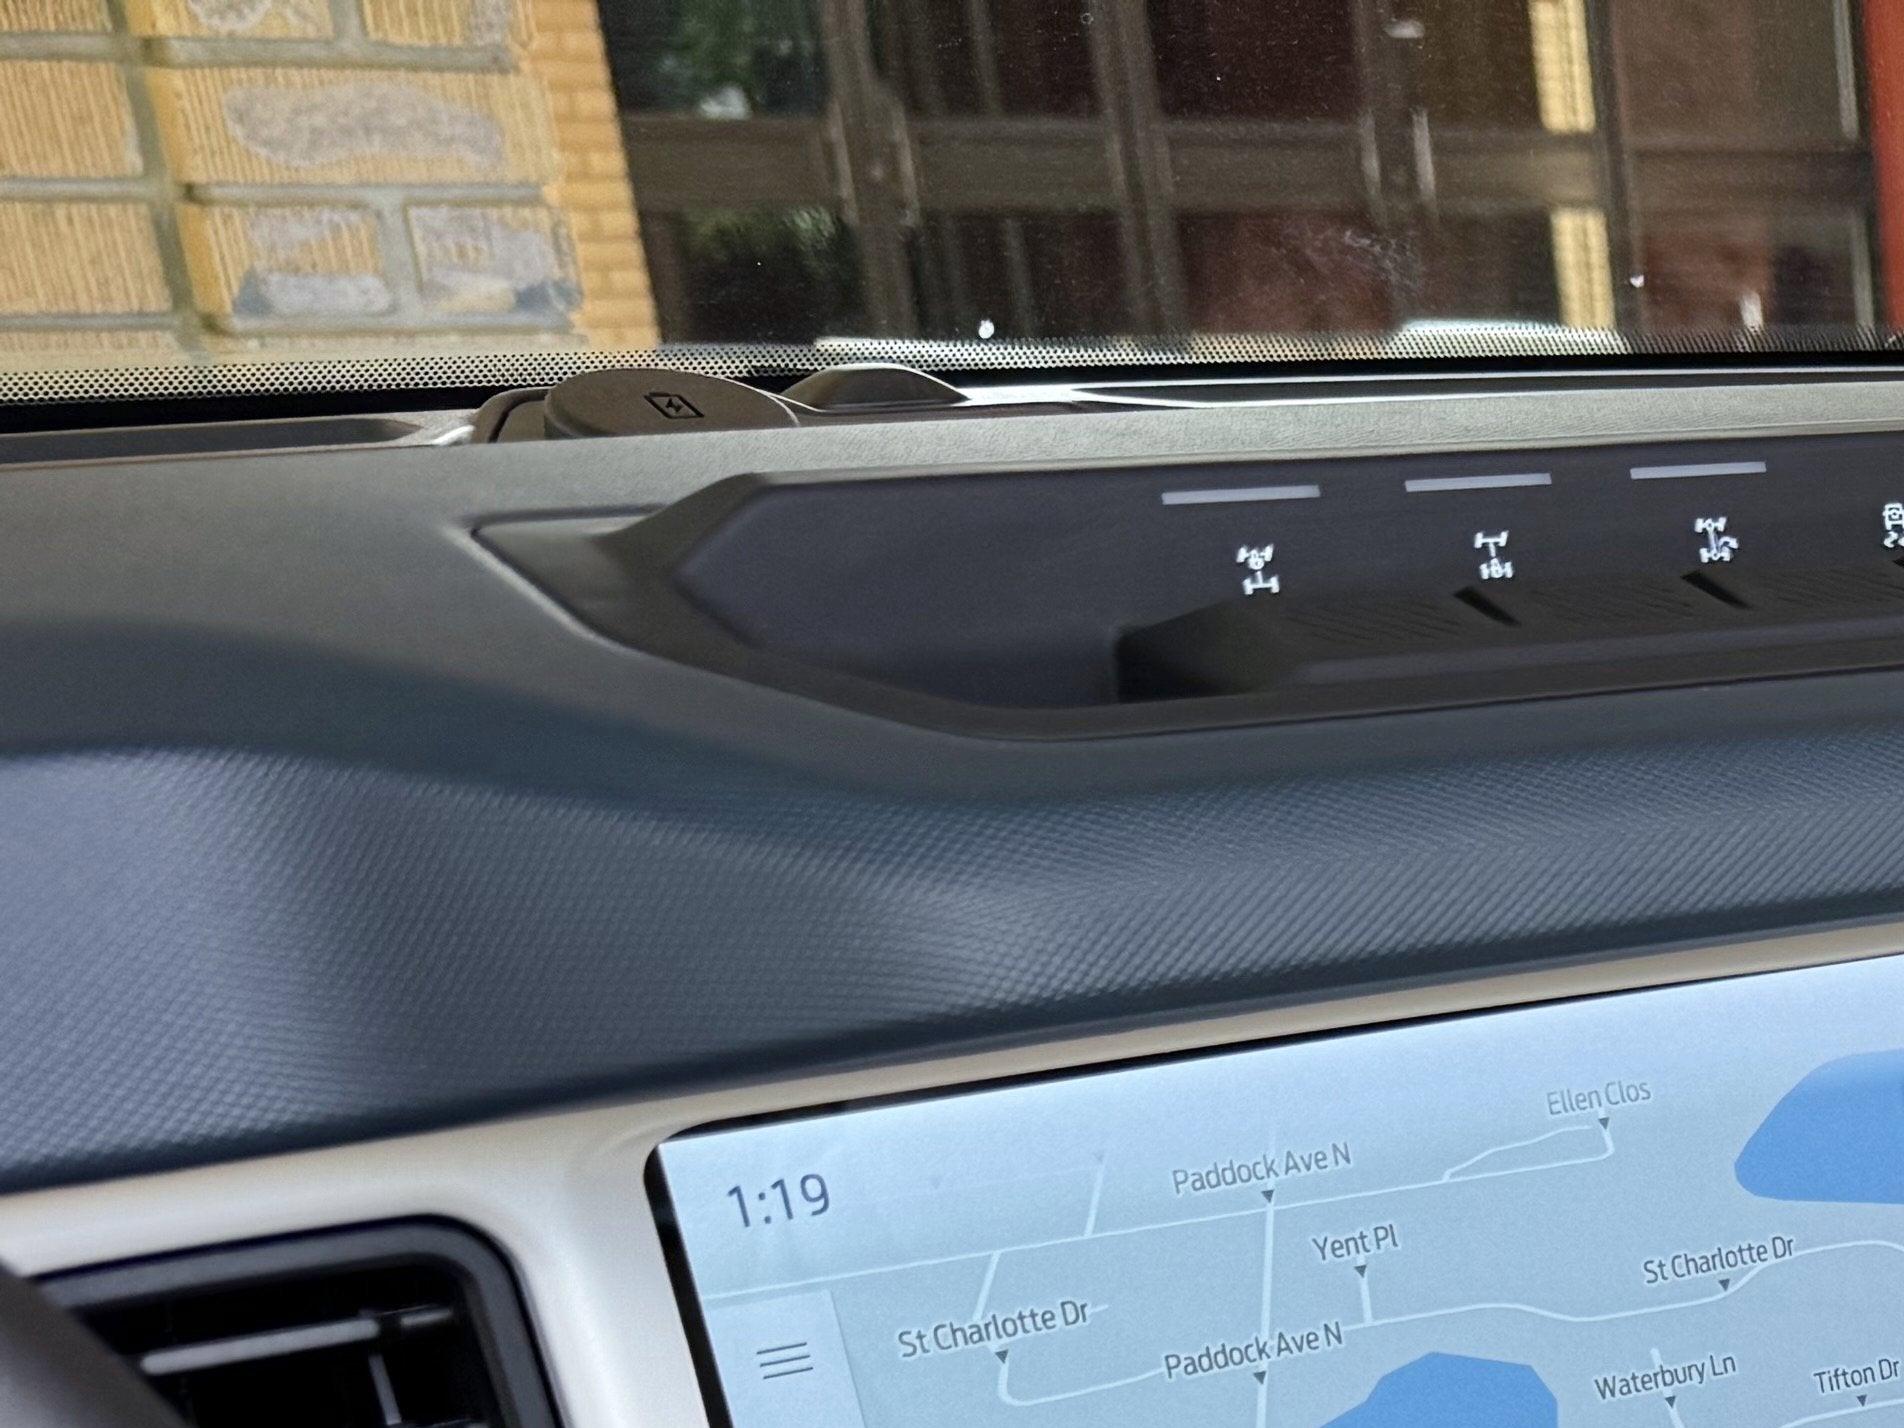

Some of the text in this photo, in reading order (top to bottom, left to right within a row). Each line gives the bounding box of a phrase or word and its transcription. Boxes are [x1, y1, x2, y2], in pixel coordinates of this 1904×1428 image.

[1546, 1079, 1652, 1118] Ellen Clos
[1172, 1143, 1352, 1195] Paddock Ave N
[727, 1173, 832, 1230] 1:19
[1312, 1225, 1398, 1264] Yent Pl
[1642, 1234, 1795, 1286] St Charlotte Dr
[898, 1300, 1090, 1360] St Charlotte Dr
[1164, 1323, 1344, 1380] Paddock Ave N
[1594, 1352, 1737, 1402] Waterbury Ln
[1814, 1355, 1901, 1397] Tifton Dr
